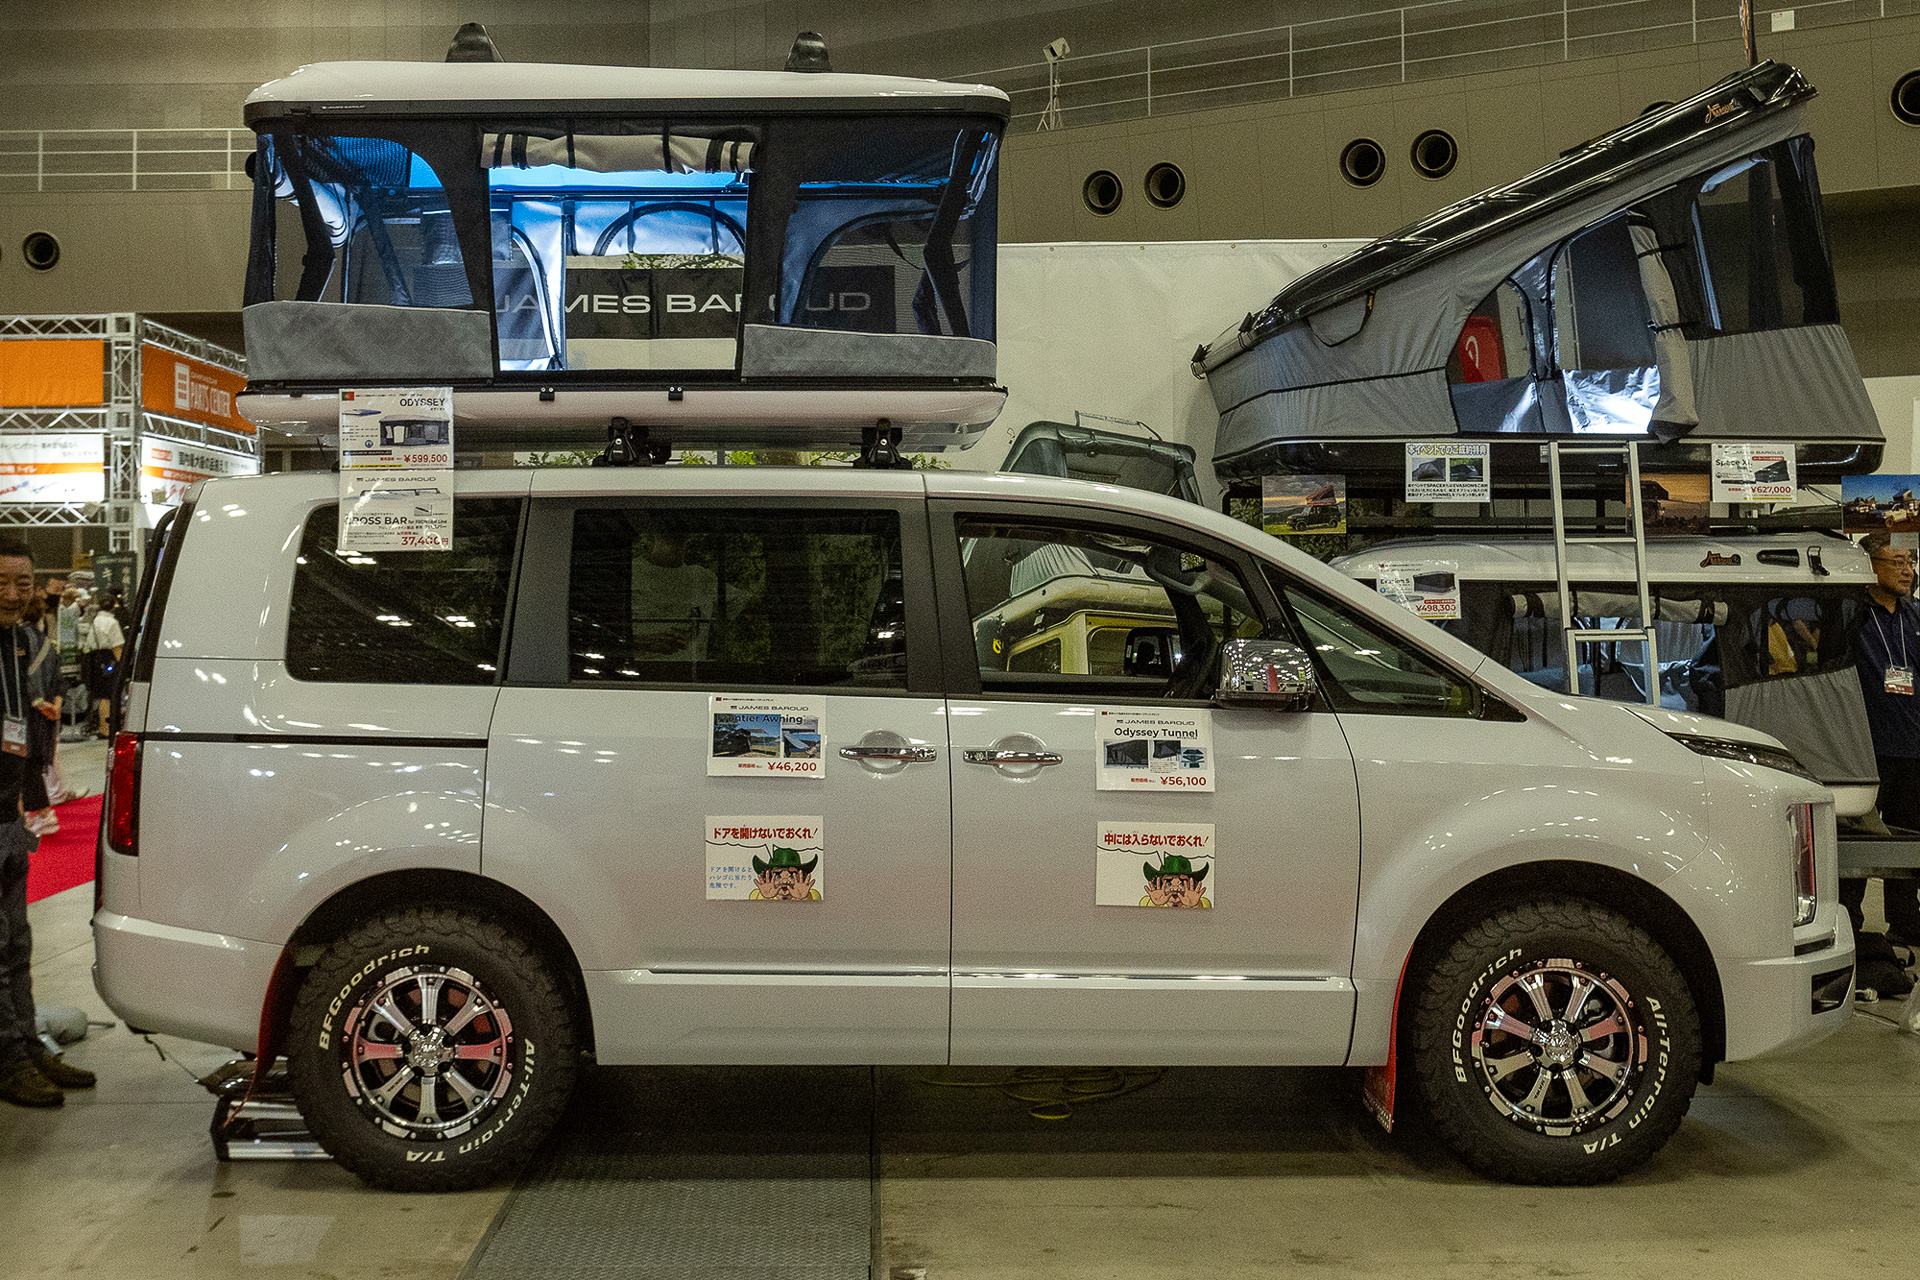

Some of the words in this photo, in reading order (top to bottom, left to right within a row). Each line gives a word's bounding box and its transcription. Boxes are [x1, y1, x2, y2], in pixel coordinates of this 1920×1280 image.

[667, 293, 870, 312] BAUD
[210, 387, 231, 418] CENTER
[400, 398, 445, 407] ODYSSEY
[1407, 444, 1487, 455] 本イベントでのご成約特典
[1715, 459, 1741, 467] Space
[1750, 486, 1791, 494] ¥627,000
[385, 516, 407, 525] BAR
[763, 715, 803, 725] Awning
[1114, 727, 1159, 739] Odyssey
[1161, 729, 1198, 738] Tunnel
[768, 762, 817, 772] ¥46,200
[1160, 776, 1207, 787] ¥56,100
[320, 945, 430, 1050] BFGoodrich
[1452, 948, 1522, 1082] BFGoodrich
[1628, 996, 1670, 1130] All-Terrain
[459, 1038, 535, 1154] All-Terrain
[1583, 1132, 1622, 1154] T/A
[406, 1150, 446, 1163] T/A
